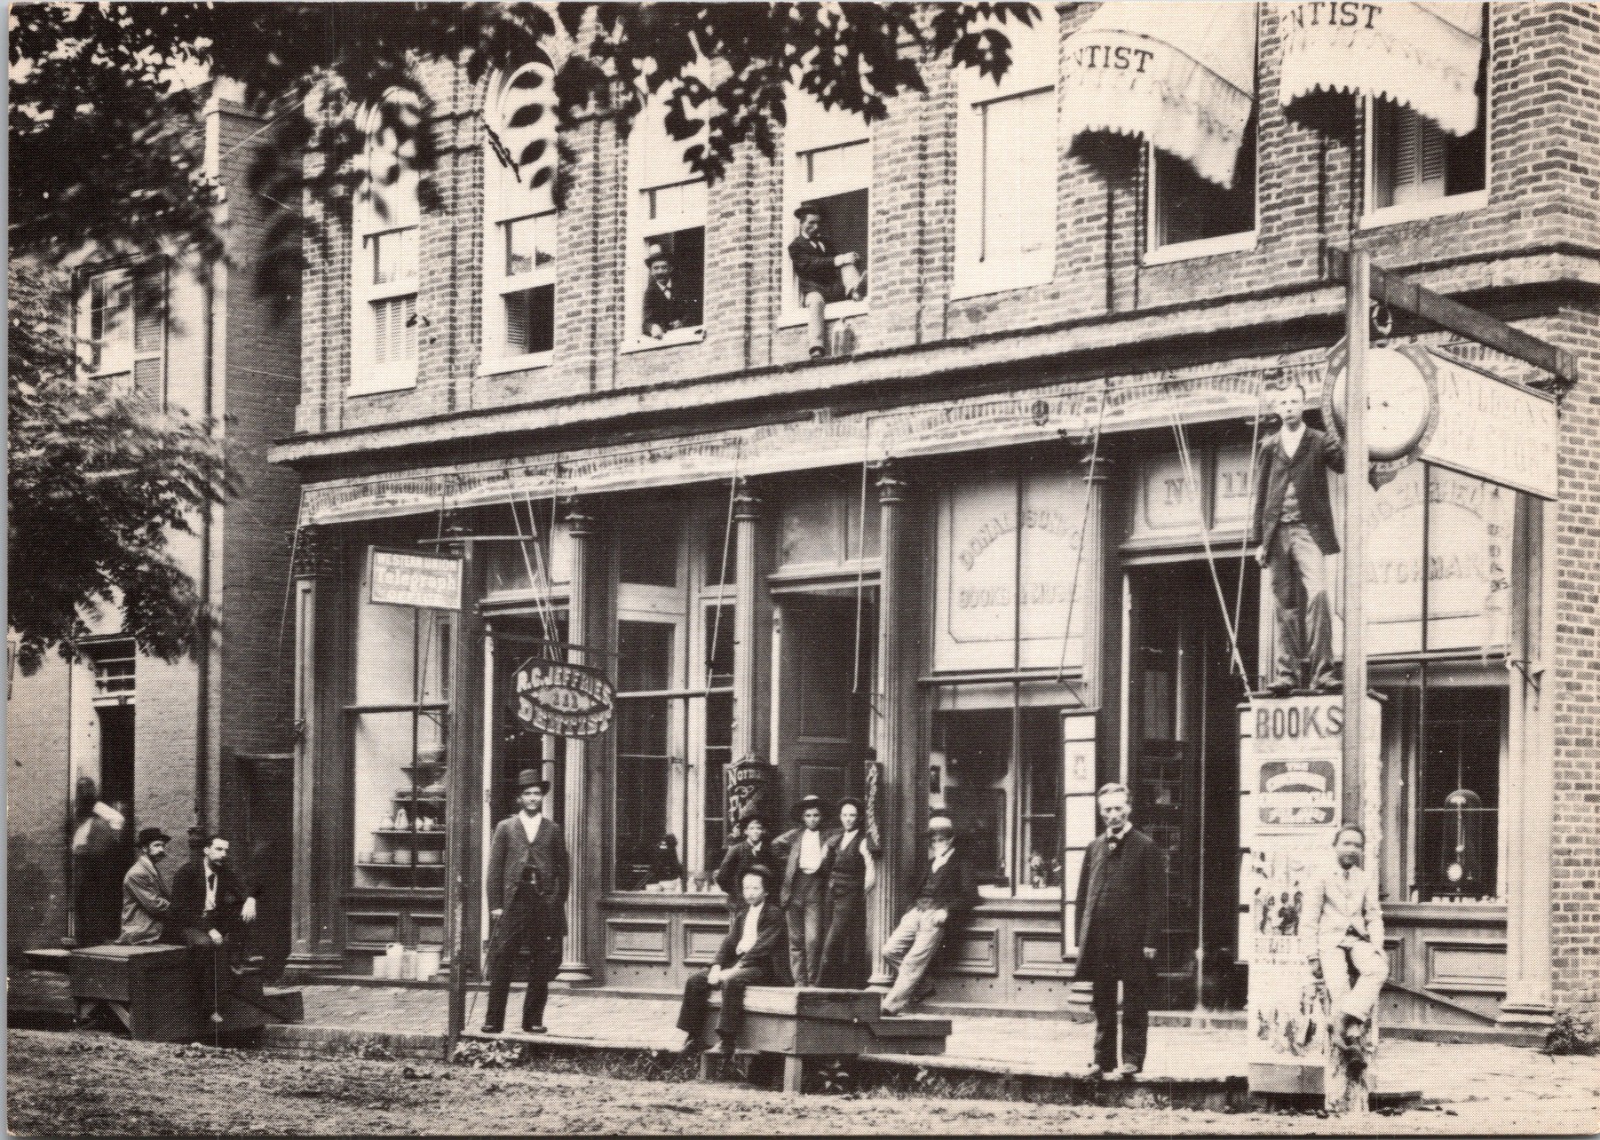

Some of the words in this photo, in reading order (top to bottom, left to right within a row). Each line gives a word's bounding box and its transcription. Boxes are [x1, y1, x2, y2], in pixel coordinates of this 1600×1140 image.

[1073, 45, 1154, 73] NTIST
[375, 566, 457, 592] Telegraph
[1256, 705, 1345, 739] BOOKS
